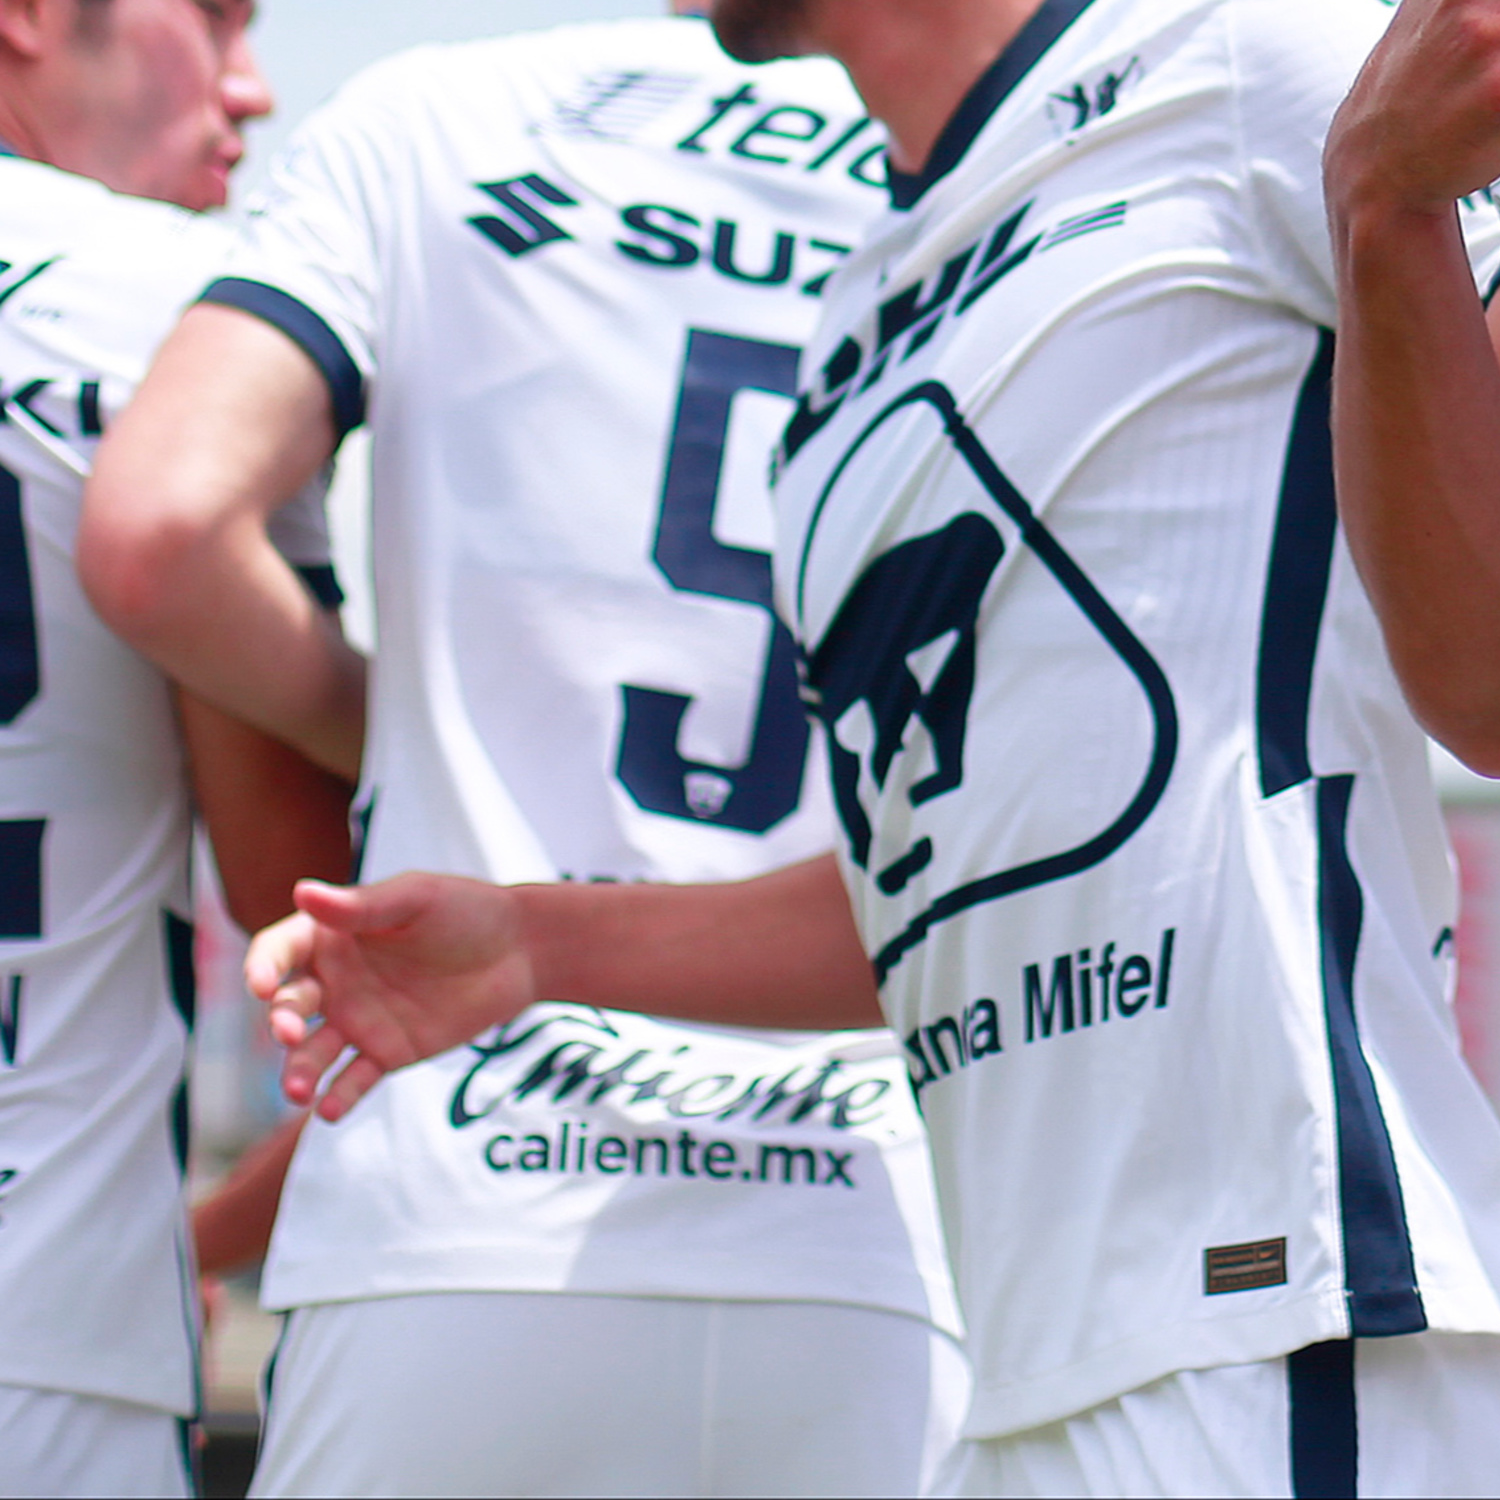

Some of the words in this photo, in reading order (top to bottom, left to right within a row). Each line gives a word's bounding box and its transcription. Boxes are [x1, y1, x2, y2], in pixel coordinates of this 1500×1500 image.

[615, 325, 812, 836] 5
[1023, 926, 1176, 1044] Mifel
[484, 1121, 857, 1190] caliente.mx
